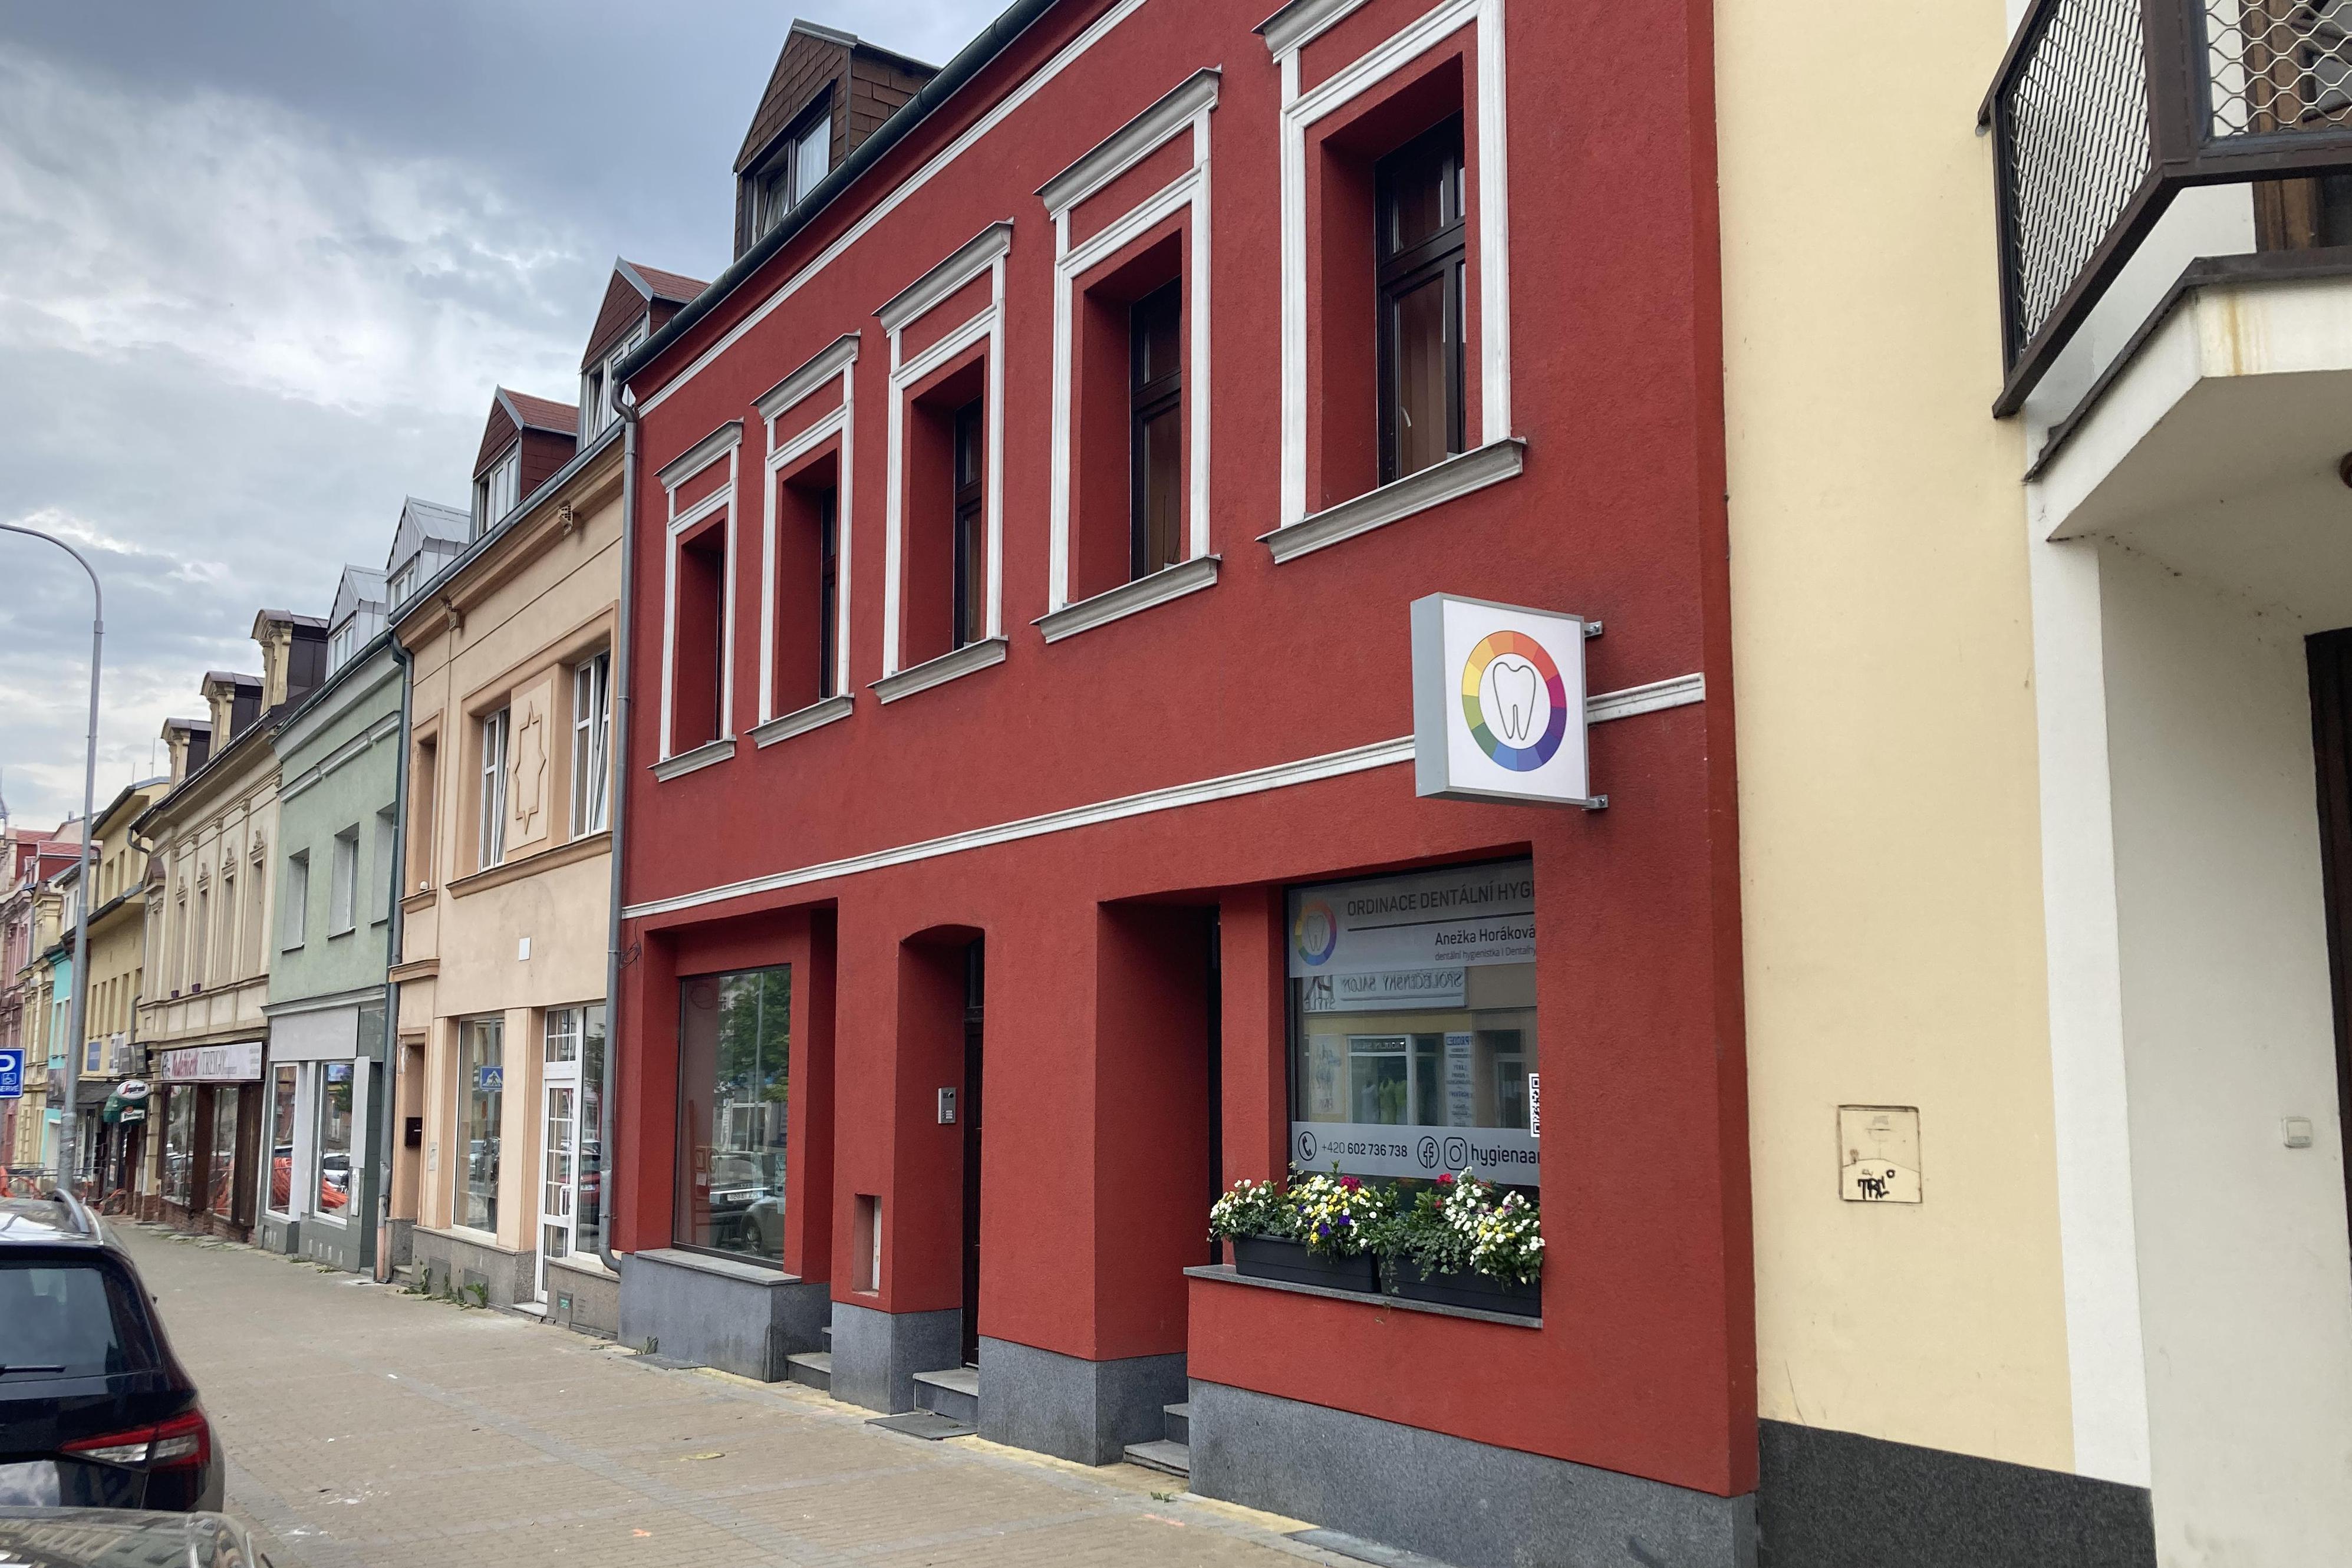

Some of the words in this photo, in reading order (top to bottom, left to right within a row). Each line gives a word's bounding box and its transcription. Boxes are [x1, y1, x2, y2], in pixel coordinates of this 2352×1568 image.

[1348, 893, 1416, 917] ORDINACE
[1421, 881, 1493, 908] DENTÁLNÍ
[1435, 930, 1476, 946] Anežka
[1479, 924, 1536, 943] Horáková
[1435, 950, 1461, 961] dentální
[1462, 948, 1500, 961] hygienistka
[1322, 1142, 1345, 1154] +420
[1348, 1142, 1366, 1155] 602
[1368, 1144, 1386, 1156] 736
[1389, 1145, 1408, 1157] 738
